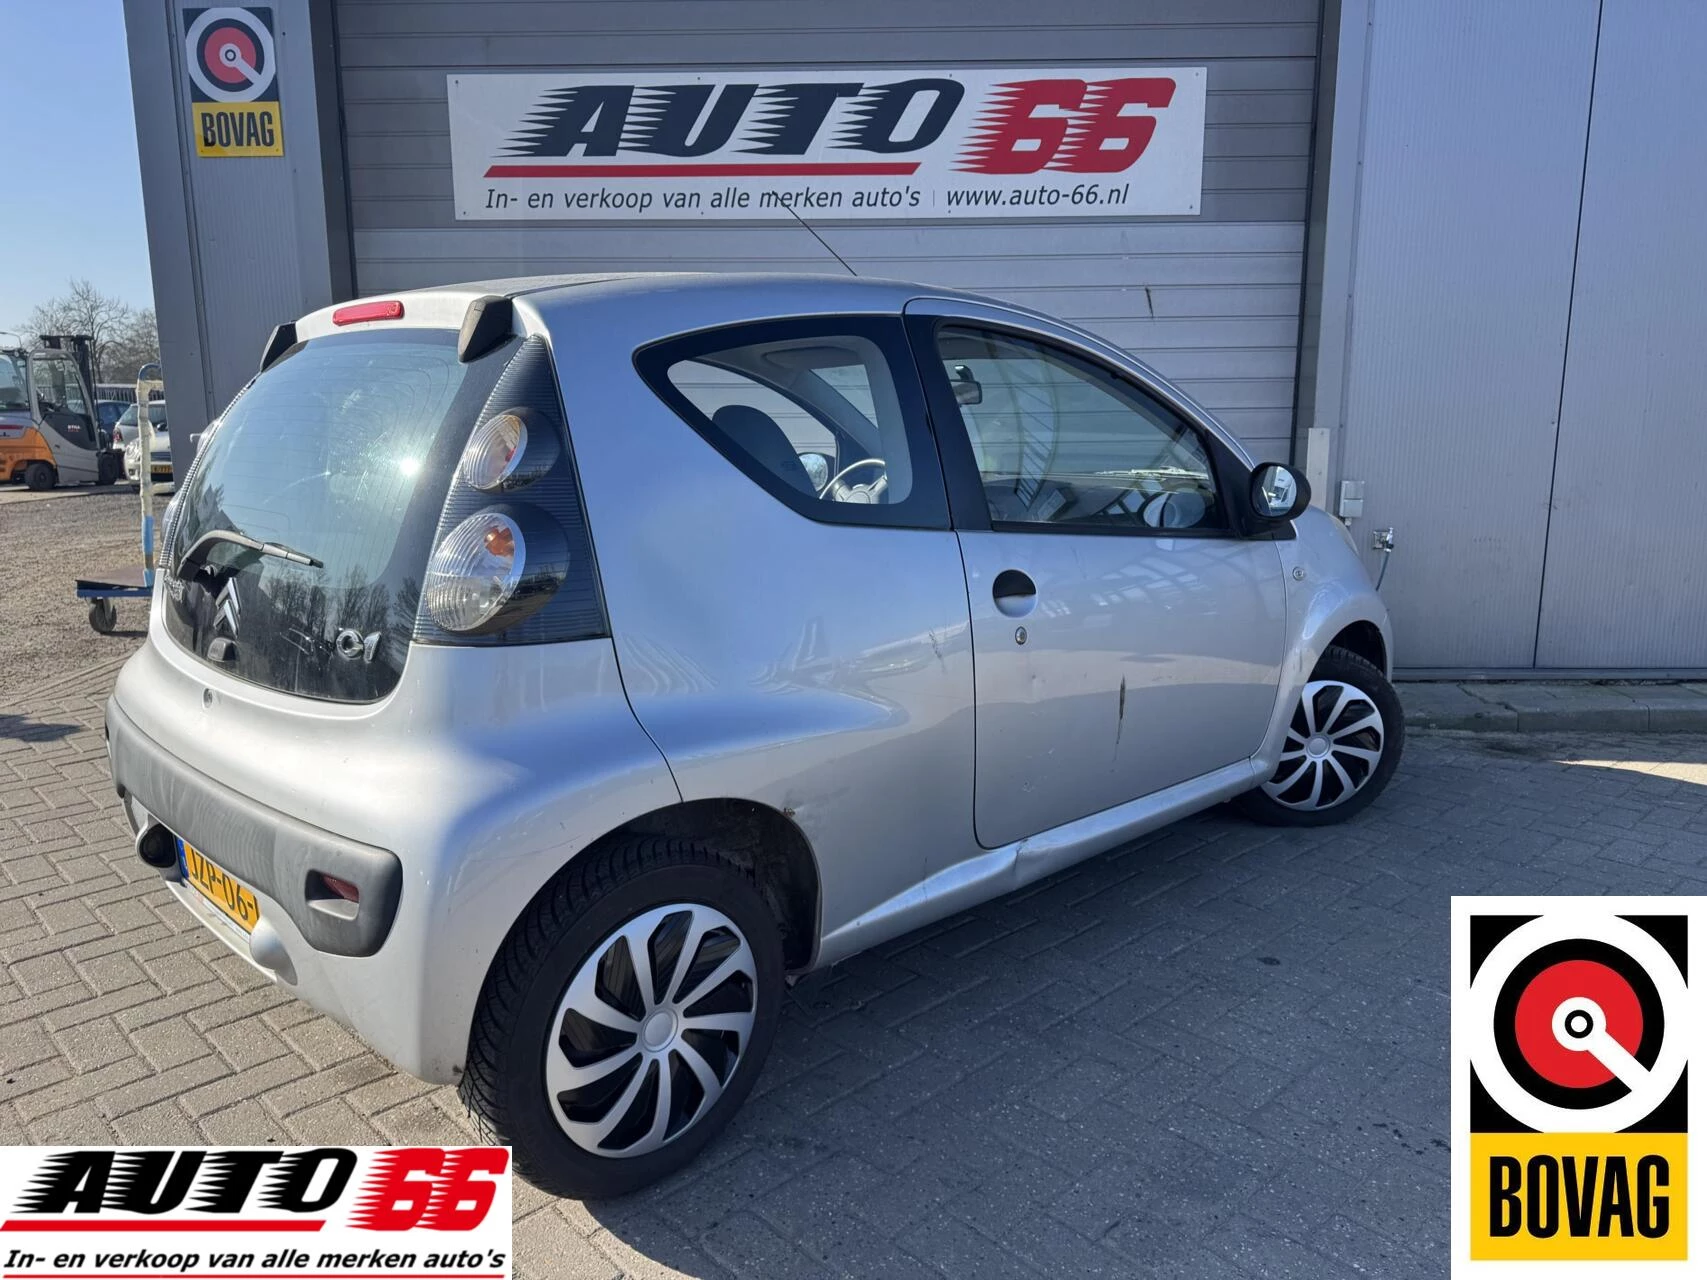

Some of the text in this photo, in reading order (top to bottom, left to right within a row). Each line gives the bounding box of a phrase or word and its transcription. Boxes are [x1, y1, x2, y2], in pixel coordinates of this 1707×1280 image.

[200, 111, 274, 147] BOVAG
[489, 77, 1176, 175] AUTO 66
[485, 183, 1130, 214] In- en verkoop van alle merken auto's www.auto-66.nl
[336, 628, 381, 663] C1
[190, 847, 260, 921] JZP-06-
